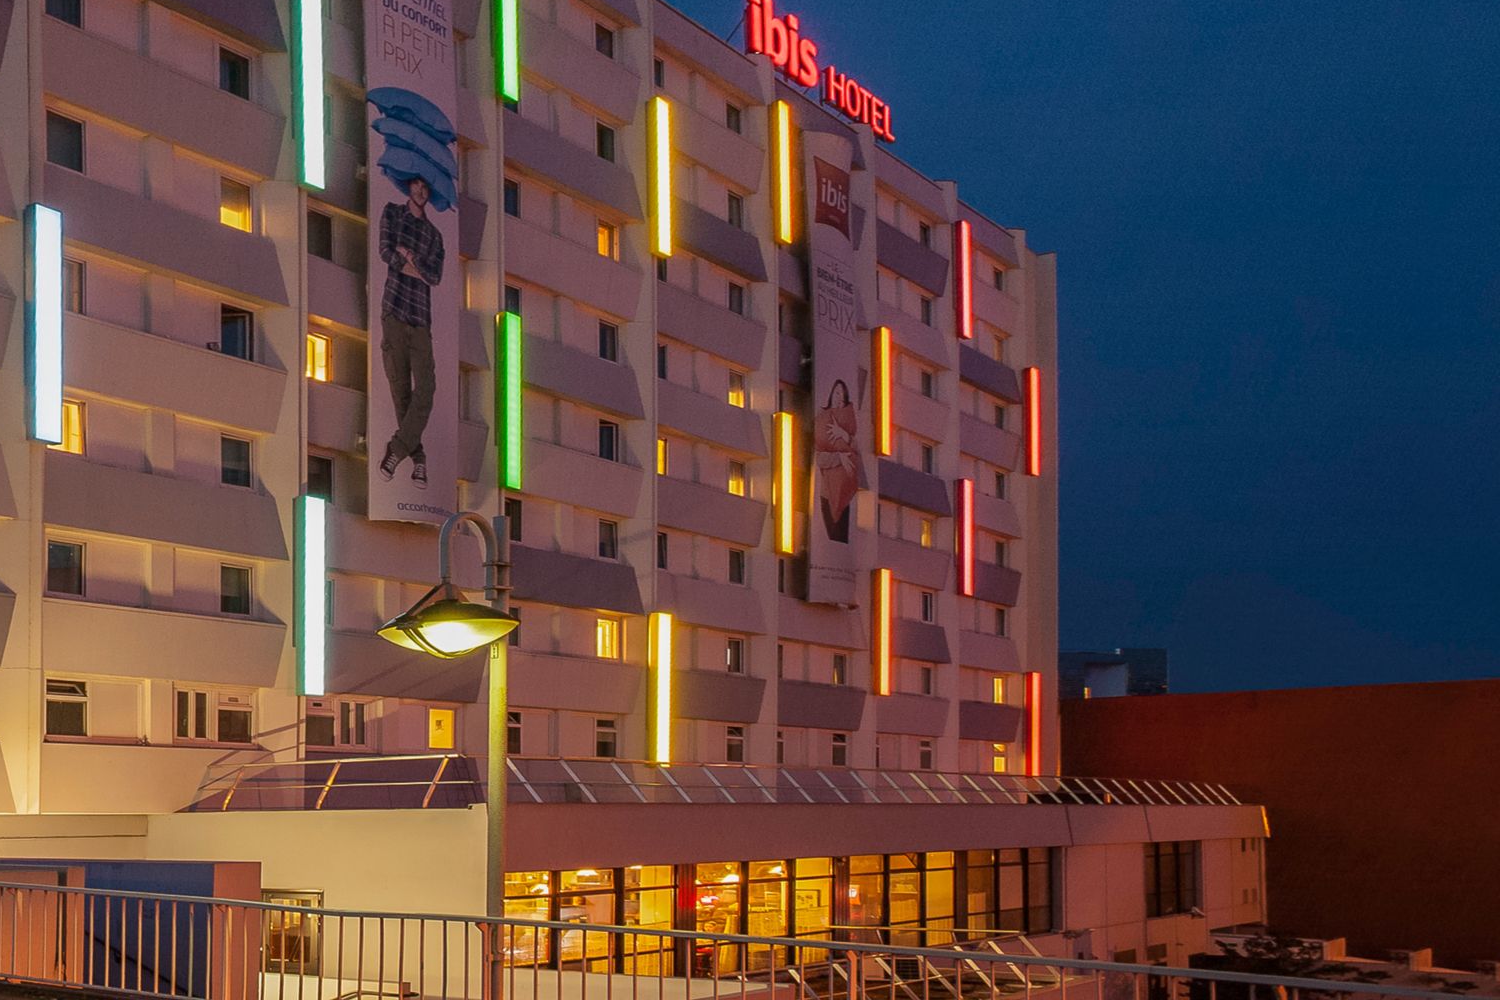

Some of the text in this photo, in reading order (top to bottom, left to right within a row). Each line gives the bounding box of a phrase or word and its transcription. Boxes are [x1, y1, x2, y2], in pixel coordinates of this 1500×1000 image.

[401, 3, 448, 39] CONFORT
[383, 40, 424, 79] PRIX
[400, 21, 448, 64] PETIT
[826, 65, 896, 143] HOTEL
[821, 178, 848, 214] ibis
[818, 293, 855, 337] PRIX
